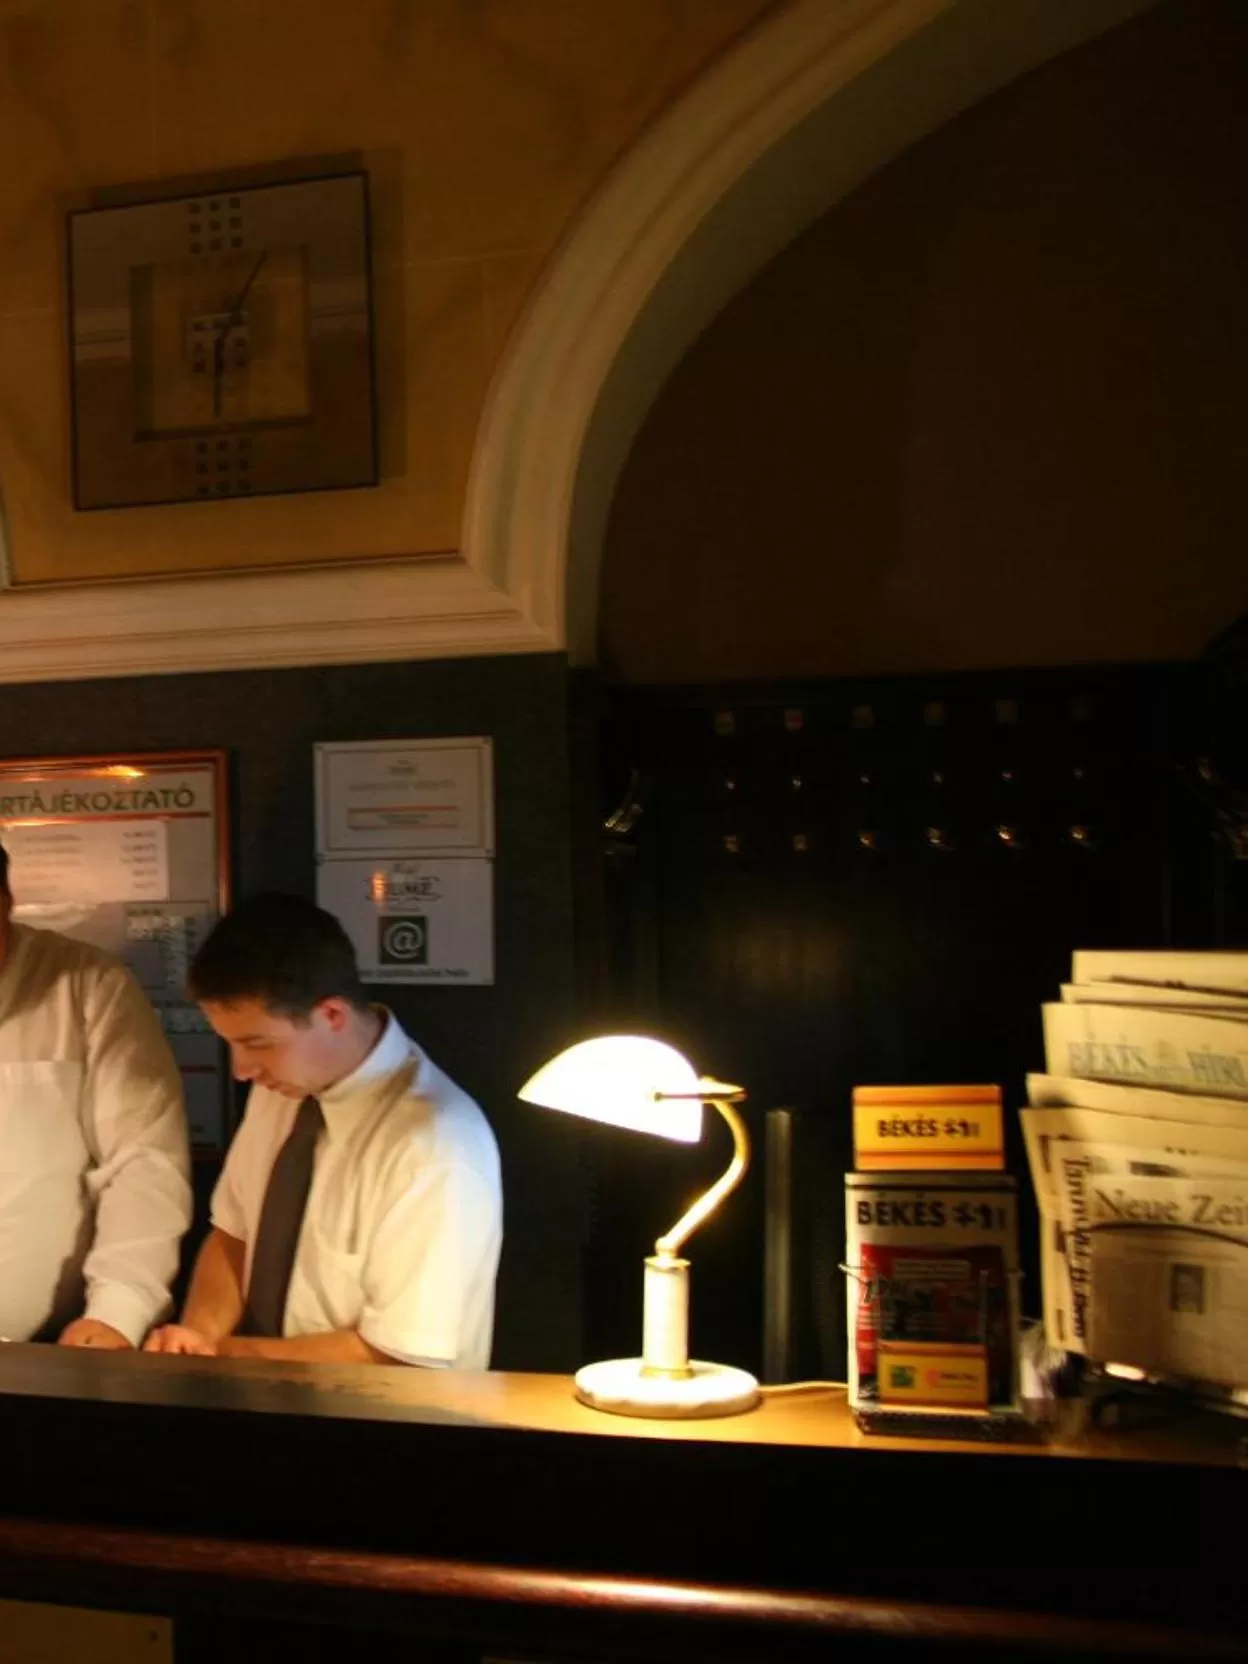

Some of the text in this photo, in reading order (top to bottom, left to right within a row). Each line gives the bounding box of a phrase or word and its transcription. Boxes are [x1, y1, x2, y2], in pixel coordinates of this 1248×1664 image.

[877, 1114, 938, 1138] BÉKÉS
[857, 1193, 947, 1227] BÉKÉS
[1188, 1194, 1248, 1227] Zei
